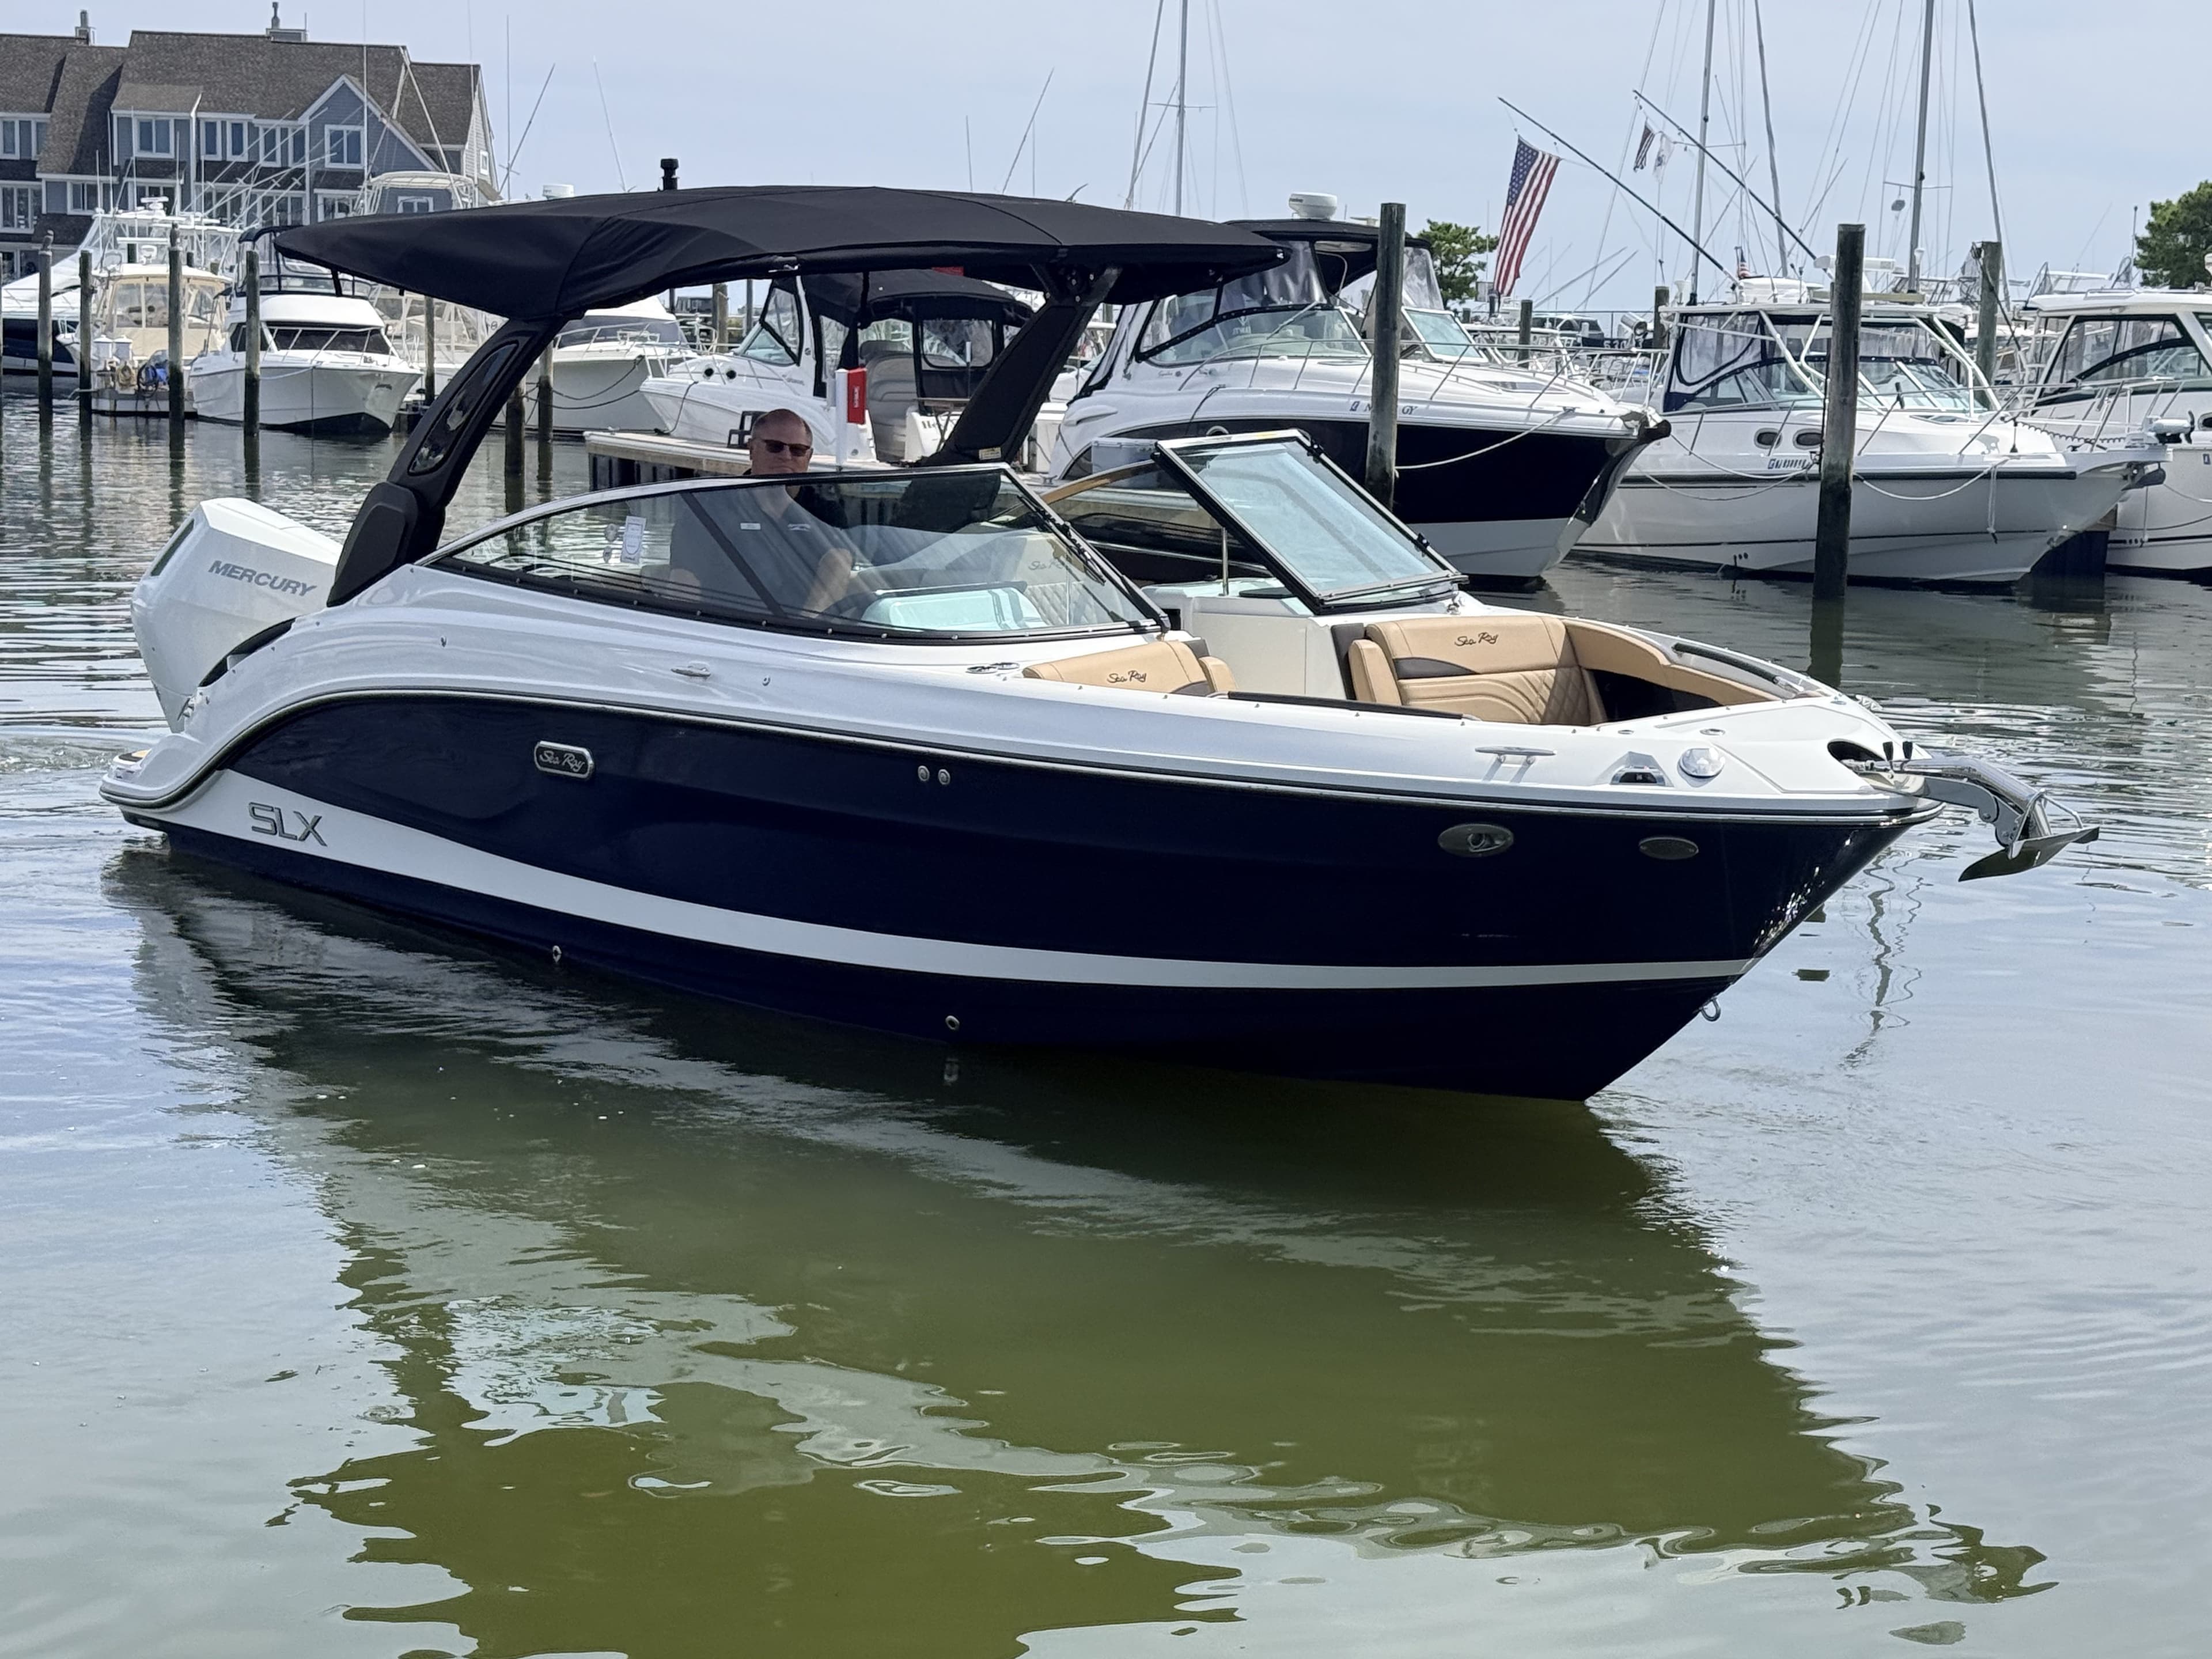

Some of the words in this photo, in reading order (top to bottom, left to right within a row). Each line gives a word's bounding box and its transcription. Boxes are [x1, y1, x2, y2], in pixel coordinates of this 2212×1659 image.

[208, 560, 317, 596] MERCURY
[1454, 635, 1476, 646] Sea
[1478, 632, 1499, 645] Ray
[1107, 673, 1128, 683] Sea
[1128, 670, 1147, 683] Ray
[539, 750, 559, 764] Sea
[562, 753, 585, 772] Ray
[248, 802, 328, 847] SLX
